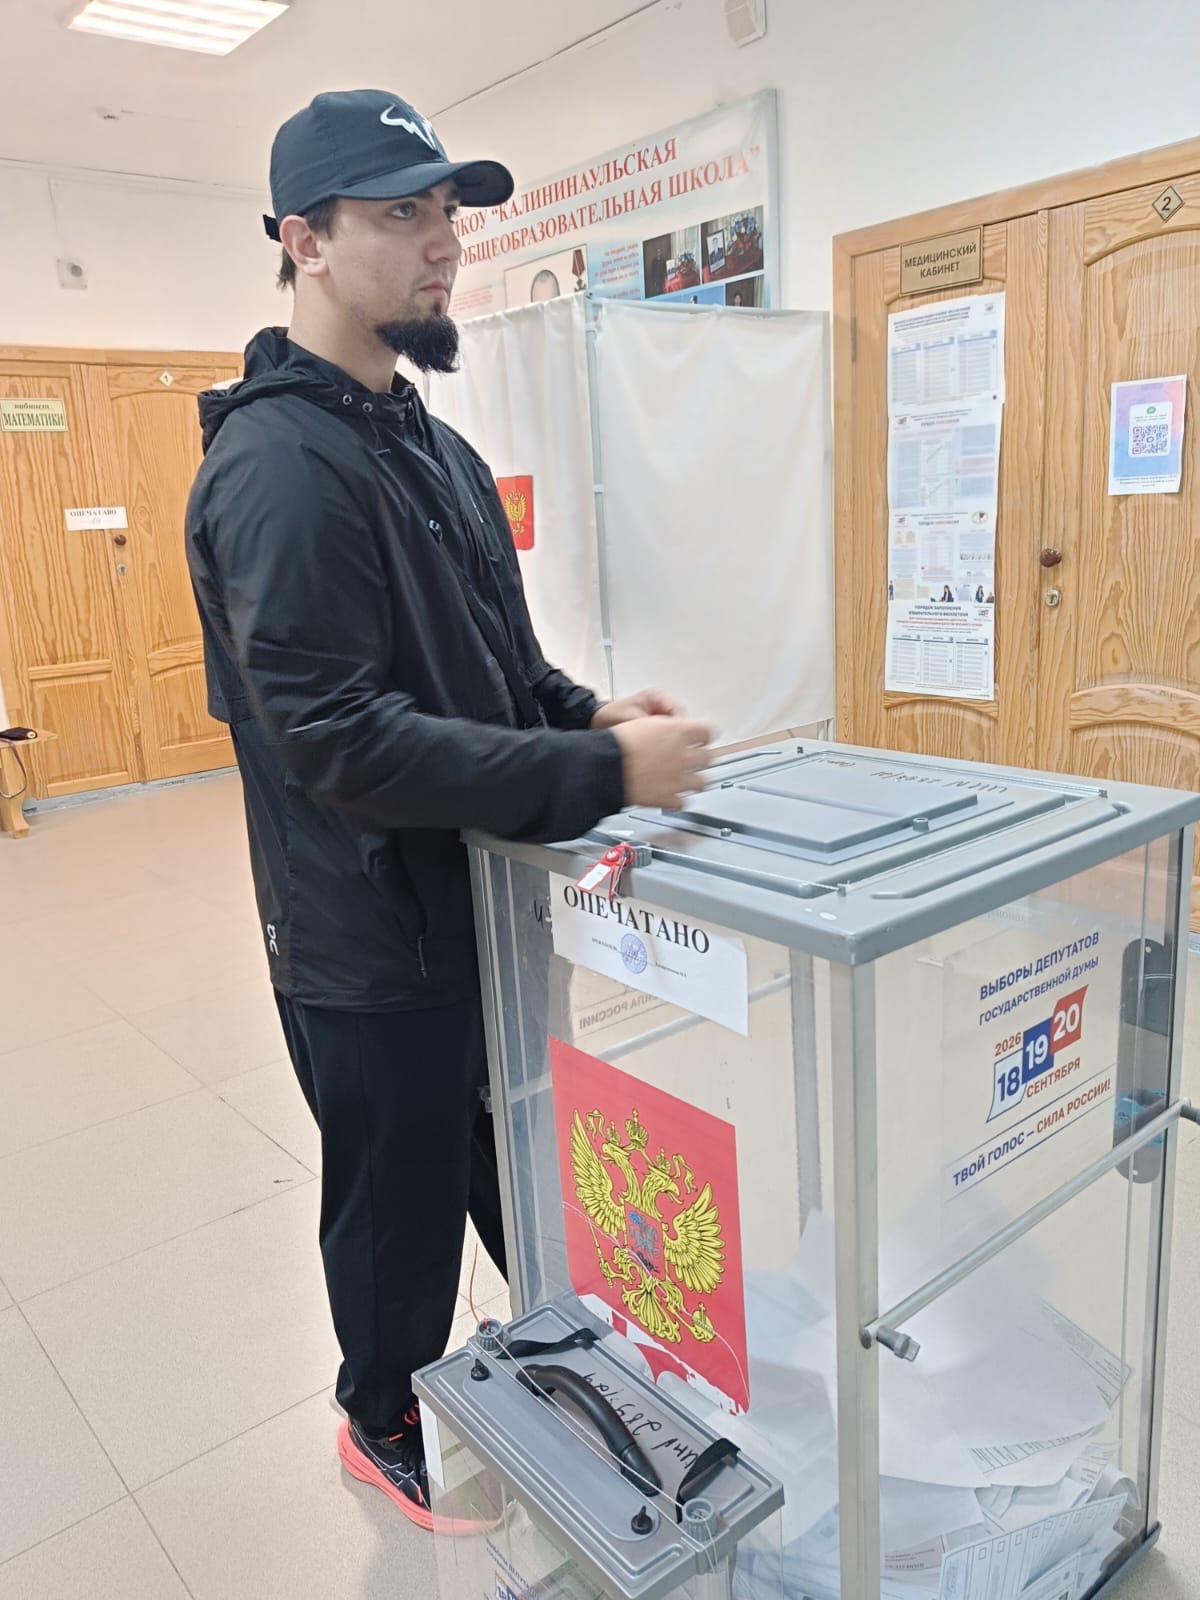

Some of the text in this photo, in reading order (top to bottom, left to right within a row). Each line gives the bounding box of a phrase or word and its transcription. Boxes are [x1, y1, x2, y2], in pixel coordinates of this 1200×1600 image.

[458, 181, 662, 268] ОБЩЕОБРАЗОВАТЕЛЬНАЯ
[1162, 196, 1172, 212] 2
[904, 242, 977, 268] МЕДИЦИНСКИЙ
[920, 260, 960, 279] КАБИНЕТ
[3, 412, 65, 427] МАТЕМАТИКИ
[564, 885, 710, 954] ОПЕЧАТАНО
[978, 956, 1099, 1026] ГОСУДАРСТВЕННОЙ ДУМЫ
[979, 931, 1100, 1000] ВЫБОРЫ ДЕПУТАТОВ
[994, 1031, 1022, 1057] 2026
[997, 1003, 1081, 1102] 18 19 20
[1026, 1057, 1081, 1098] СЕНТЯБРЯ
[953, 1154, 986, 1186] ТВОЙ
[987, 1132, 1025, 1164] ГОЛОС
[1036, 1107, 1065, 1134] СИЛА
[1066, 1078, 1112, 1117] РОССИИ!
